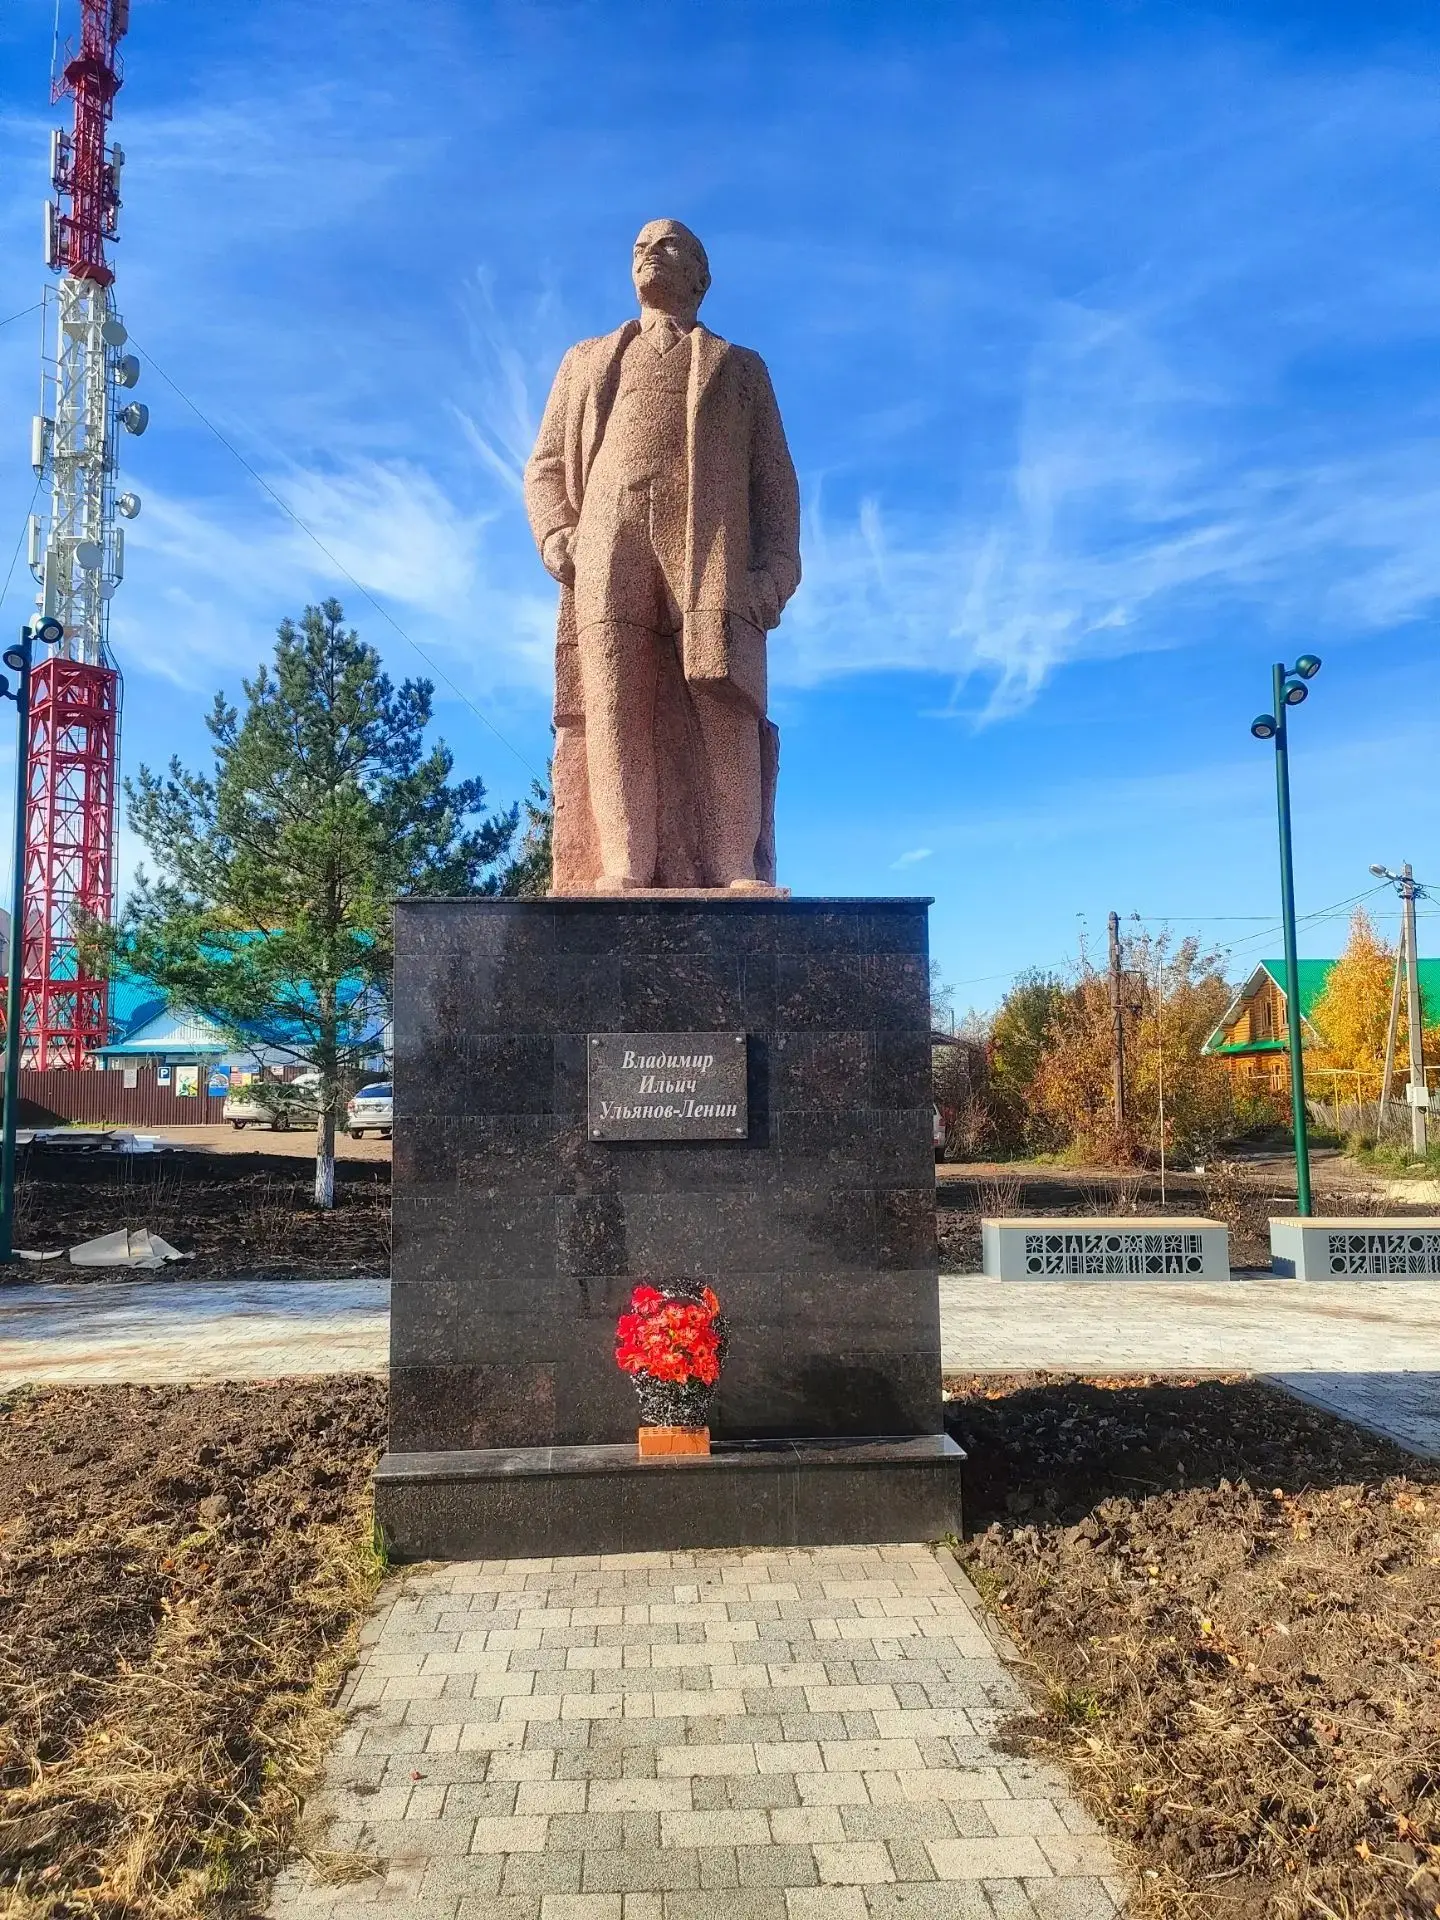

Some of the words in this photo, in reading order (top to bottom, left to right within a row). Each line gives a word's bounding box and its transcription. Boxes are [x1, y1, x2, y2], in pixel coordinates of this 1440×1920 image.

[621, 1050, 714, 1072] Владимир
[160, 1069, 169, 1078] P
[638, 1075, 697, 1094] Ильич
[600, 1100, 737, 1120] Ульянов-Ленин
